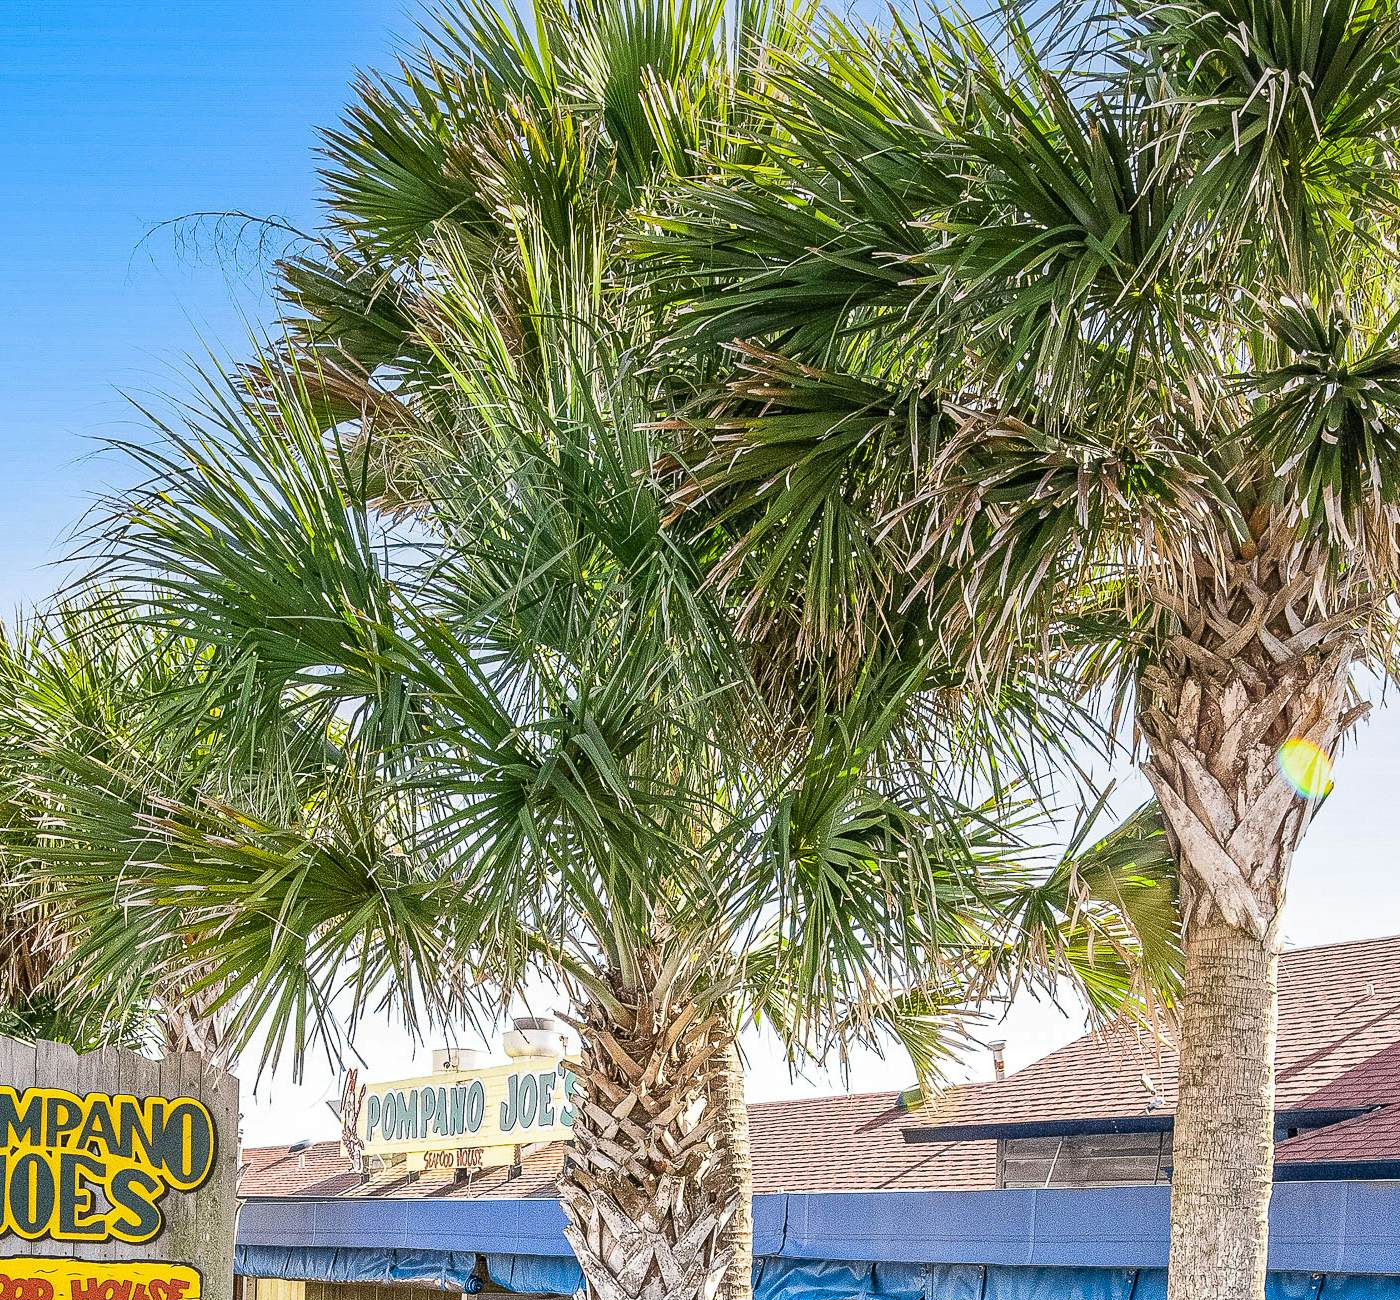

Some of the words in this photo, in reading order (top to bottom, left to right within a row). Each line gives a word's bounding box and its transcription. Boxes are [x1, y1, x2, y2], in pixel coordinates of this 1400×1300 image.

[0, 1095, 211, 1184] MPANO
[366, 1080, 485, 1142] POMPANO
[0, 1152, 159, 1236] OES
[456, 1148, 485, 1167] HOUSE
